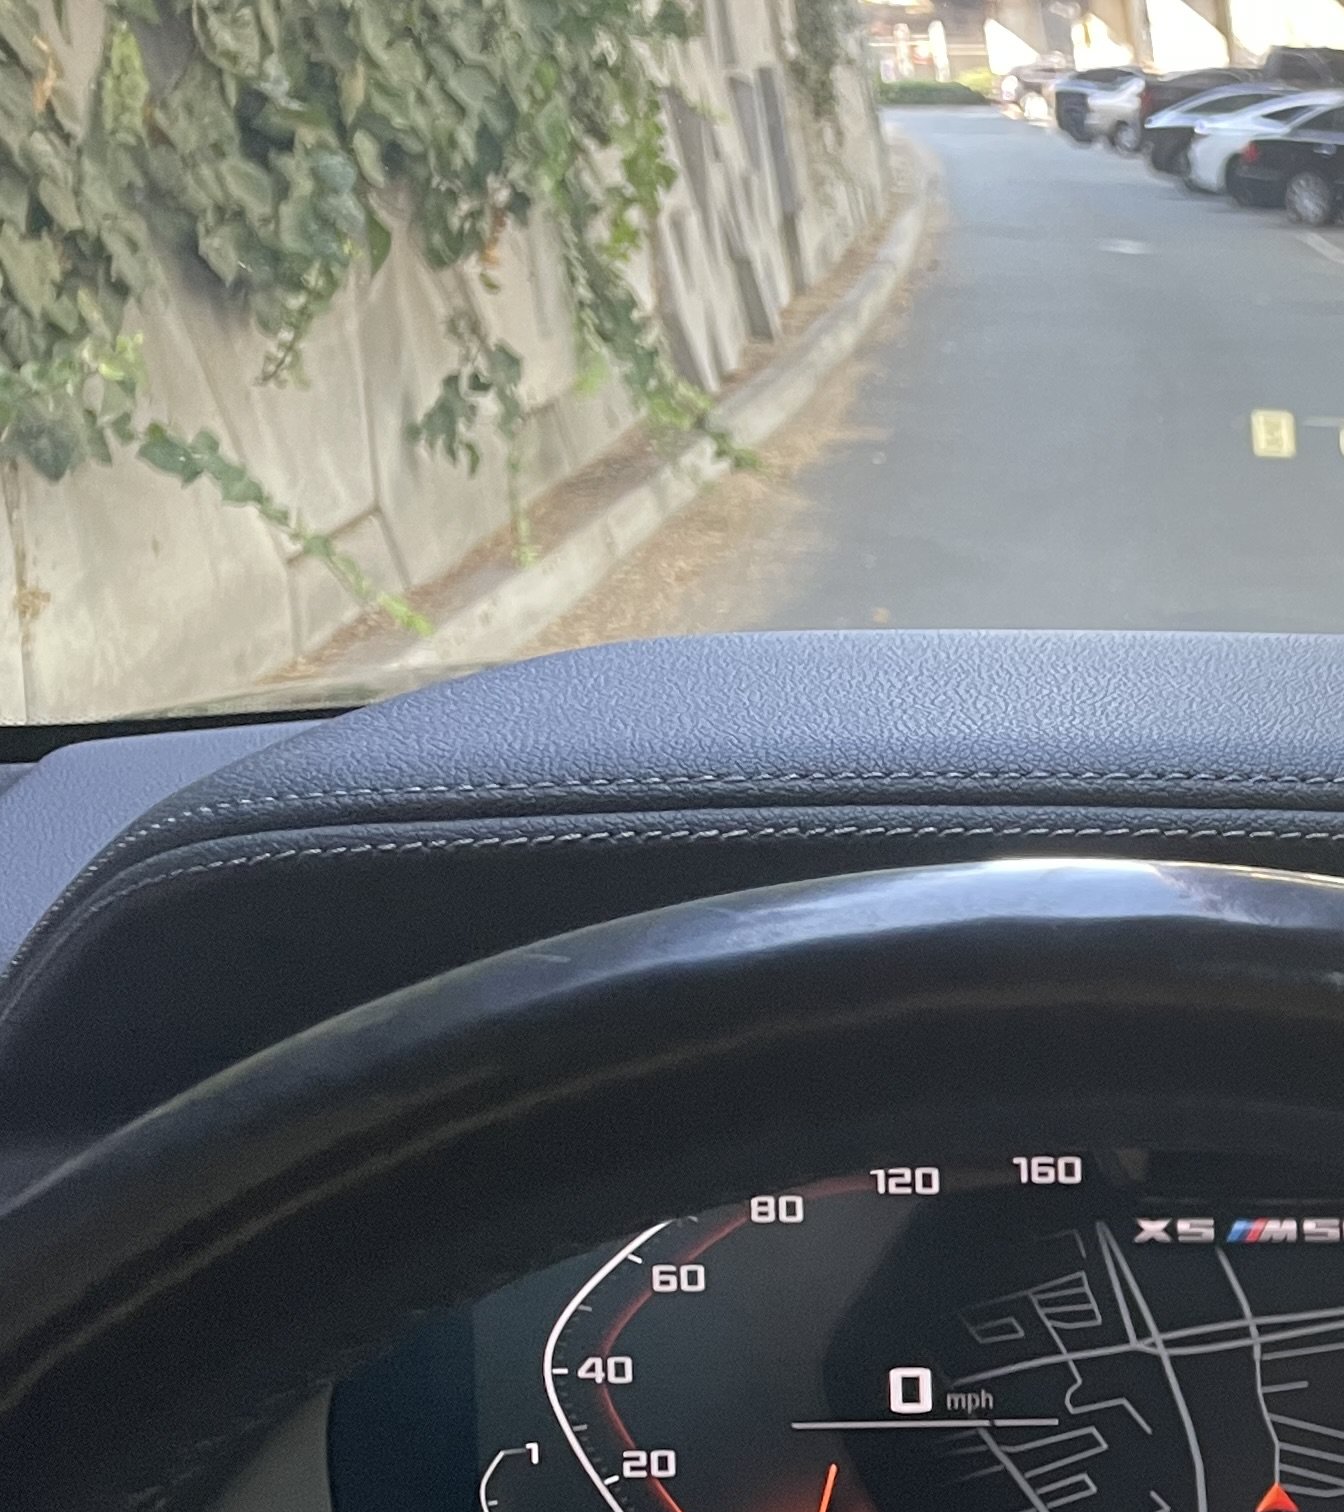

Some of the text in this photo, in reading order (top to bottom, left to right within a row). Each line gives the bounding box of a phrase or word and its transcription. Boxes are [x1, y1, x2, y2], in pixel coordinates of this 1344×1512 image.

[869, 1166, 941, 1195] 120
[1012, 1156, 1083, 1185] 160
[749, 1196, 805, 1223] 80
[1133, 1218, 1215, 1243] X5
[651, 1265, 706, 1292] 60
[577, 1356, 634, 1383] 40
[889, 1367, 994, 1415] 0 mph
[525, 1442, 540, 1464] 1
[622, 1450, 677, 1478] 20
